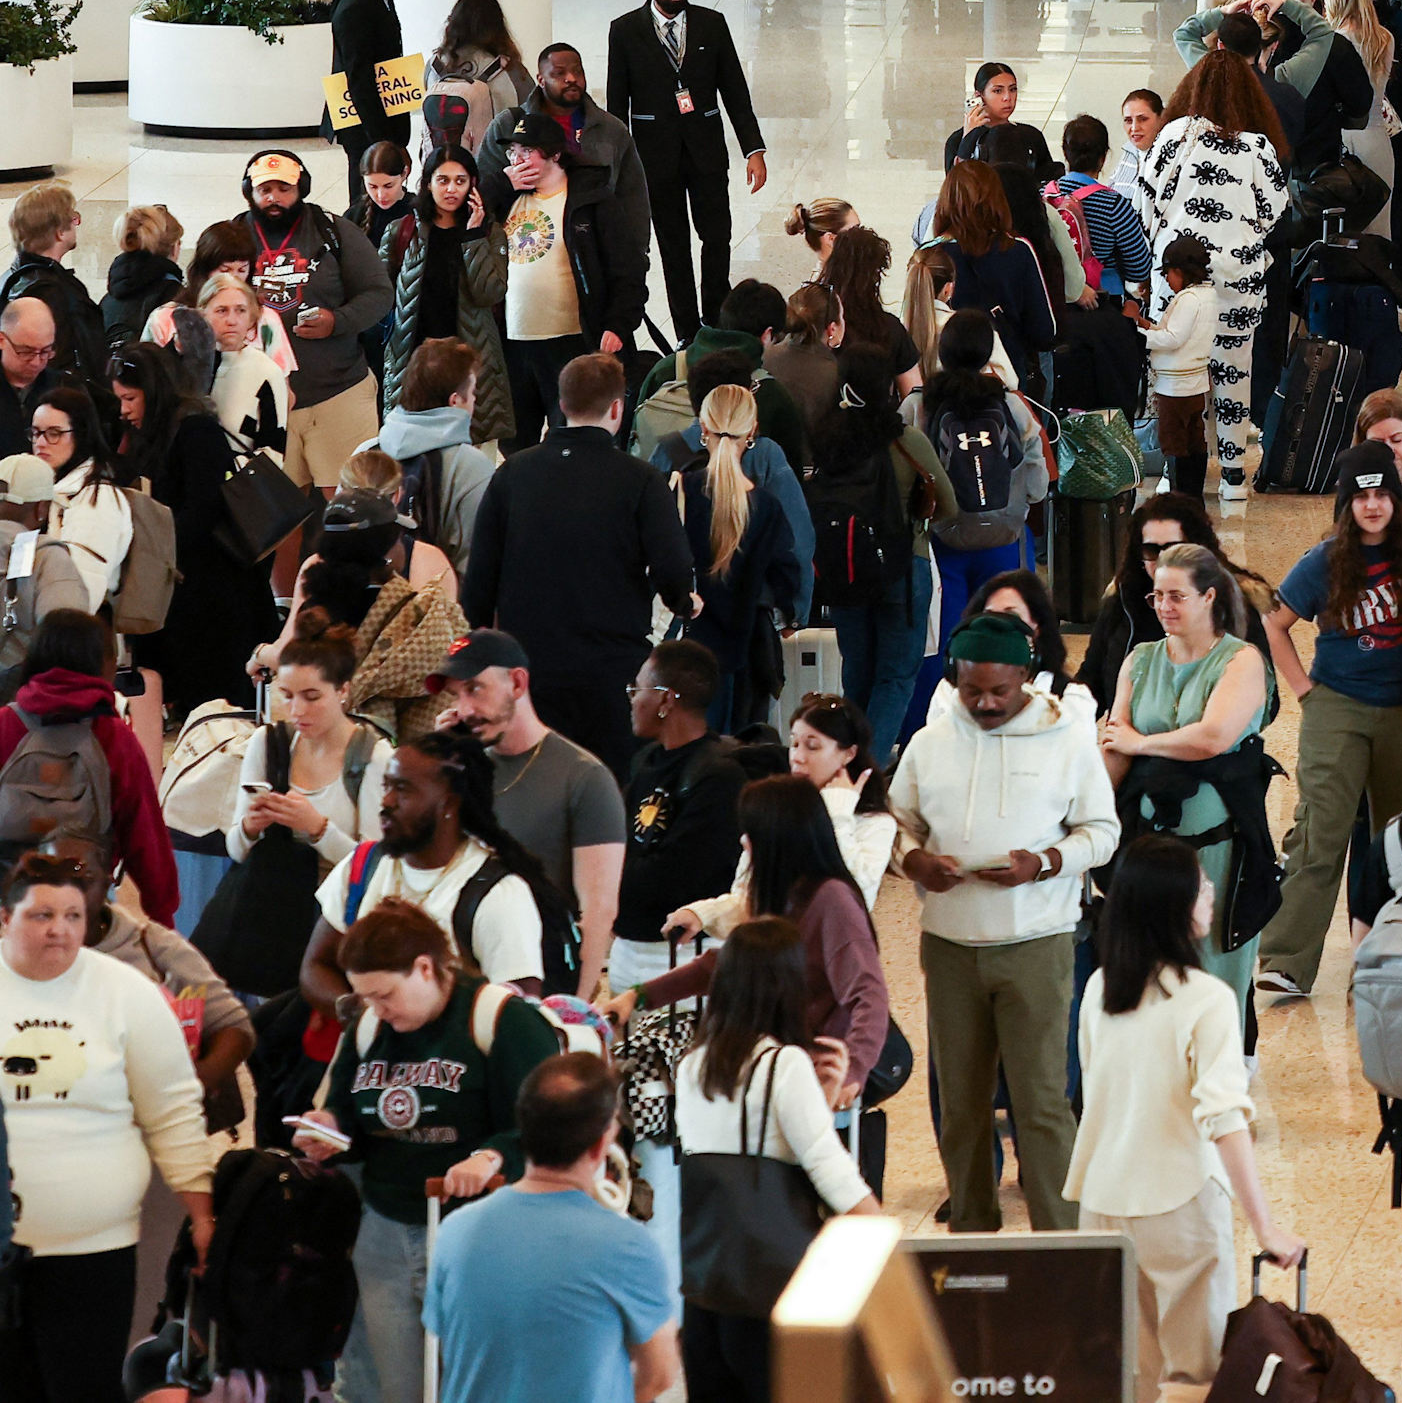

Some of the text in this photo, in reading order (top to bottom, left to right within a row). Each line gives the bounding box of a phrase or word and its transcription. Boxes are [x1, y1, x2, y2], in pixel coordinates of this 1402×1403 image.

[339, 88, 422, 118] SCNING
[950, 1371, 1056, 1397] ome to
